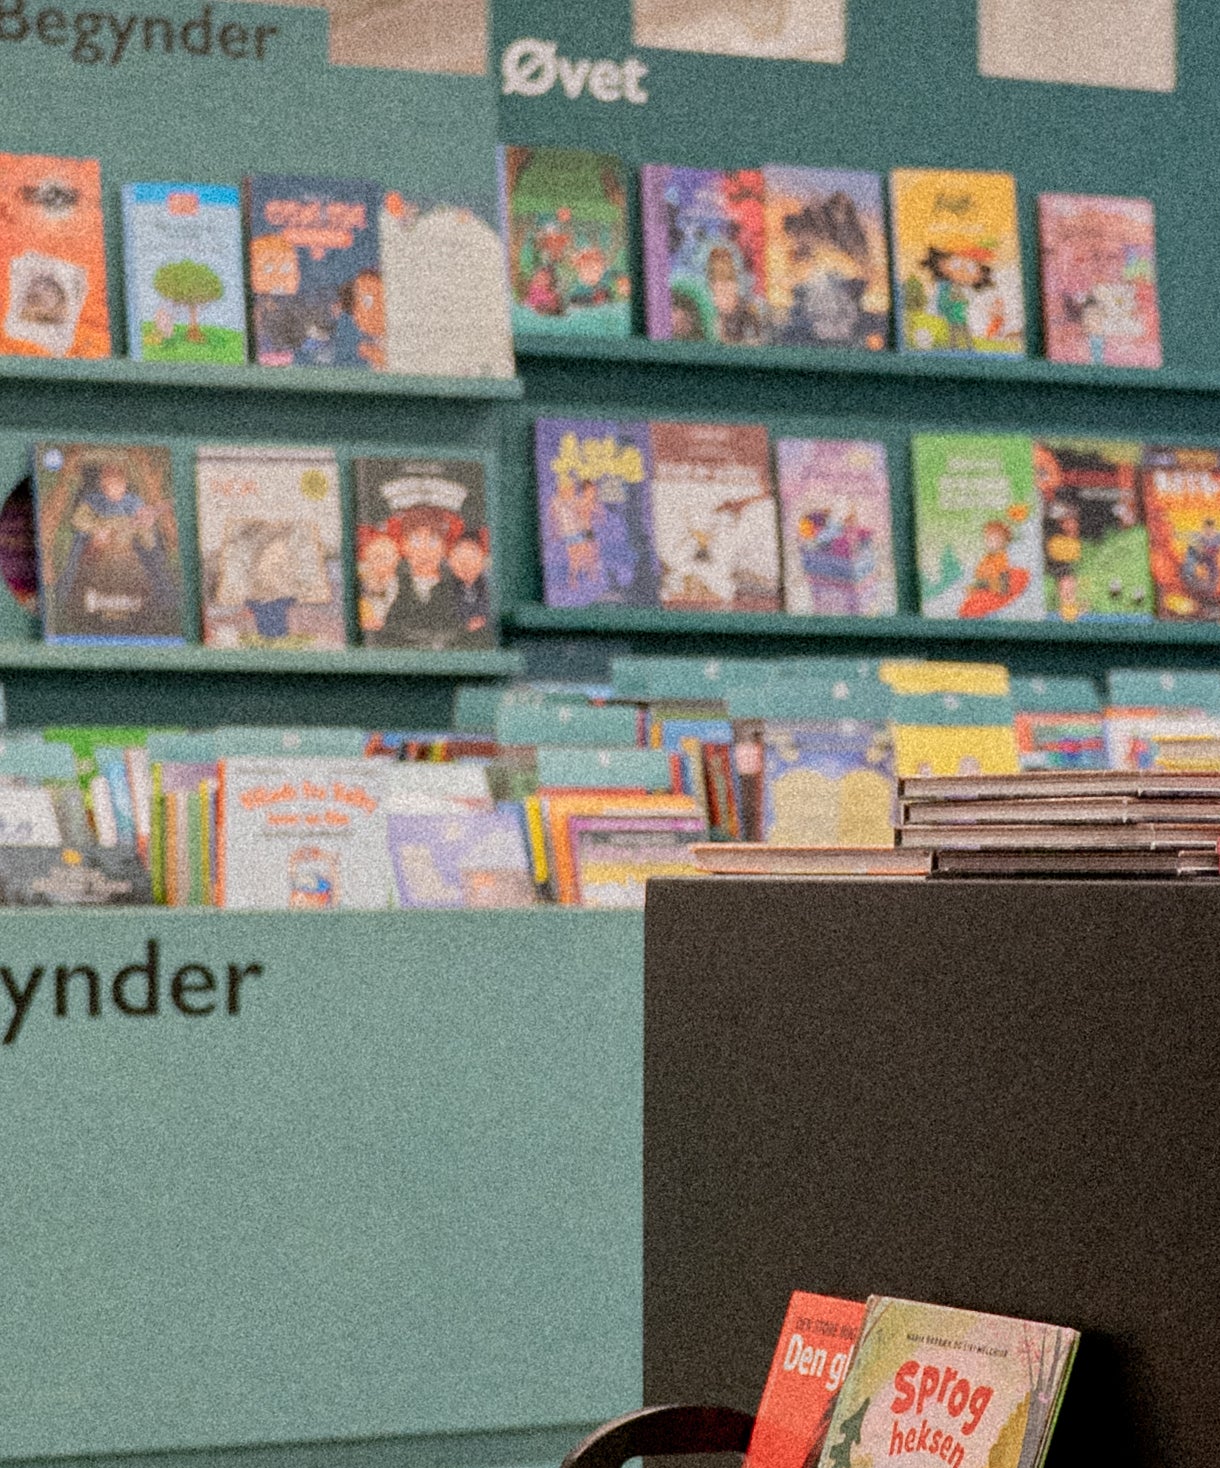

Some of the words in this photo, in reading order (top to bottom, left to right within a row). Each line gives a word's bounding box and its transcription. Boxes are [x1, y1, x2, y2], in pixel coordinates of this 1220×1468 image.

[502, 37, 649, 104] Øvet
[0, 937, 264, 1045] ynder
[783, 1333, 827, 1378] Den
[890, 1360, 994, 1436] Sprog
